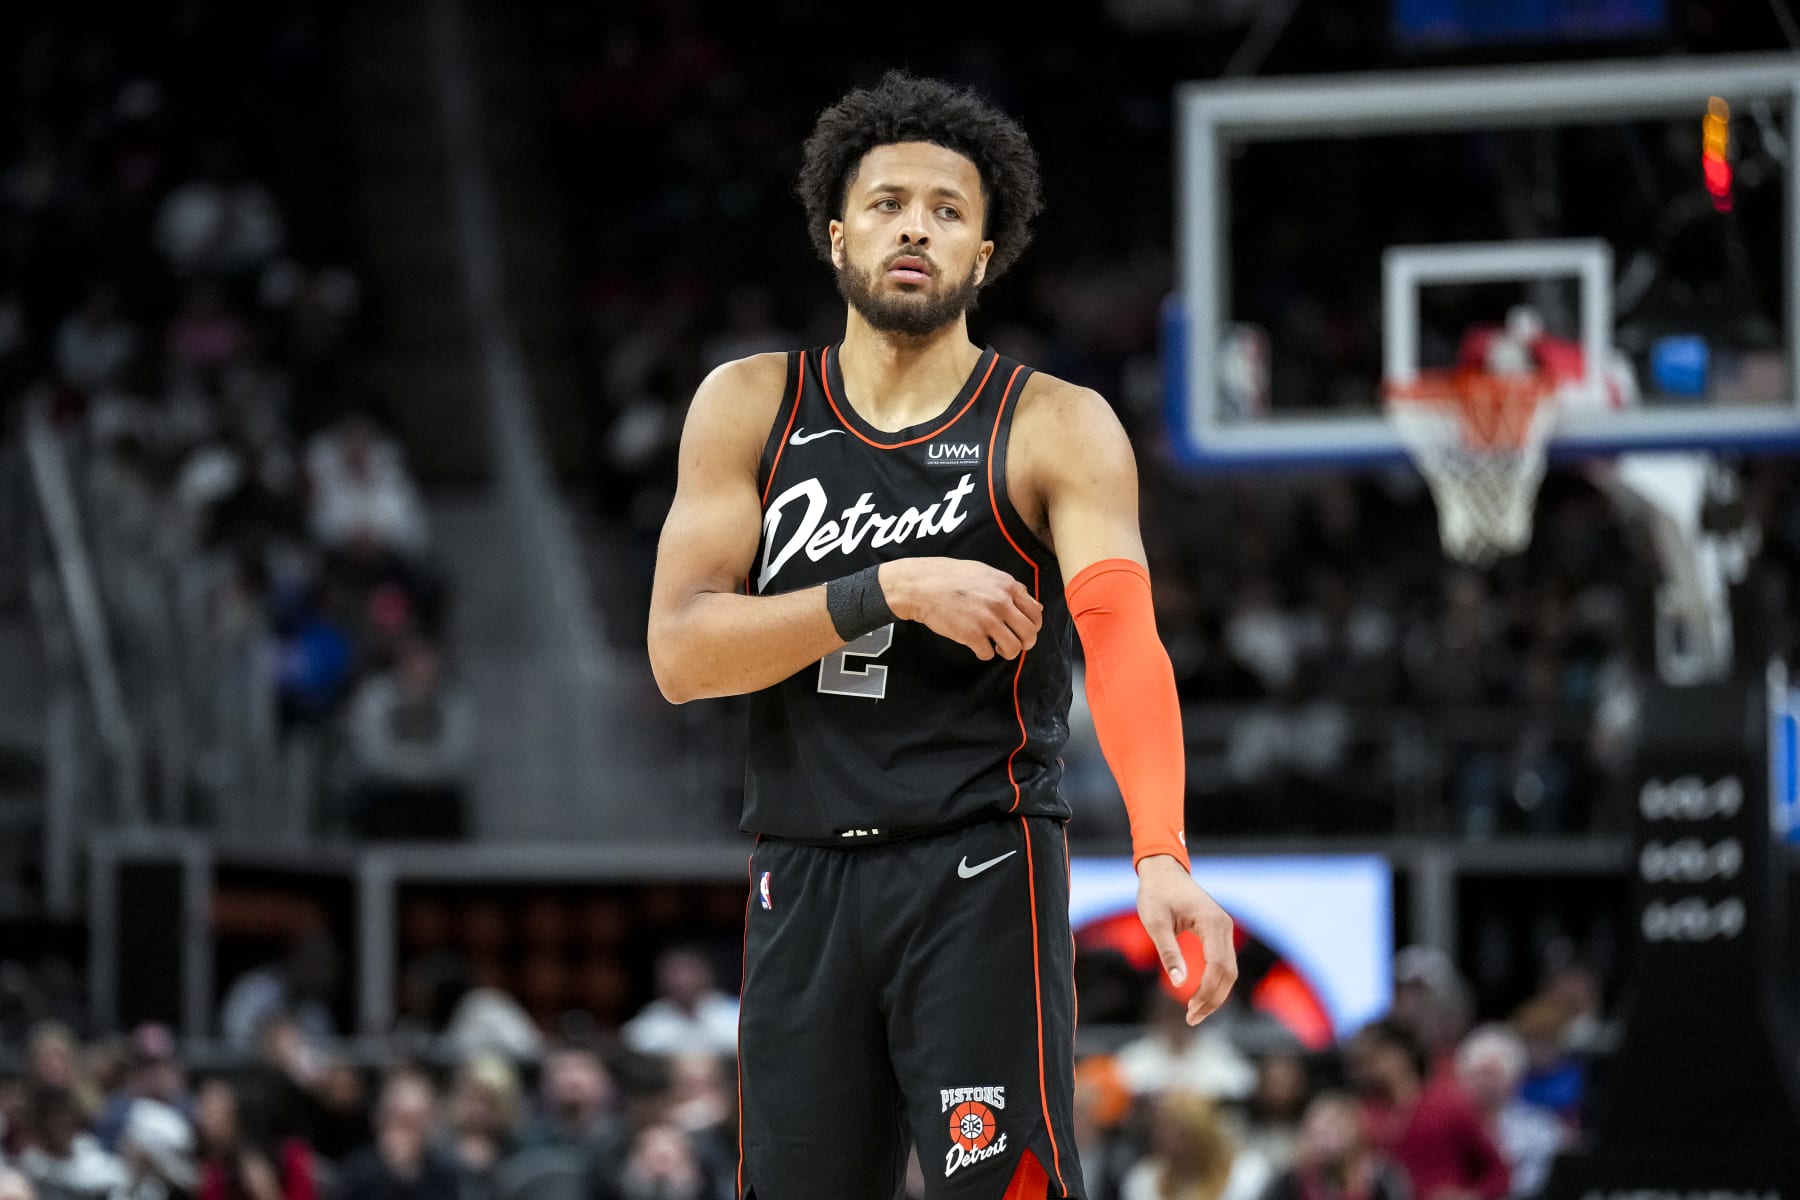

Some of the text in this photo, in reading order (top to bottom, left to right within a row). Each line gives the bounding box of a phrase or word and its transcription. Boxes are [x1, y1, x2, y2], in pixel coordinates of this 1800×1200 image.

[928, 443, 980, 459] UWM
[758, 473, 976, 594] Detroit
[940, 1086, 1005, 1113] PISTONS
[944, 1132, 1007, 1178] Detroit
